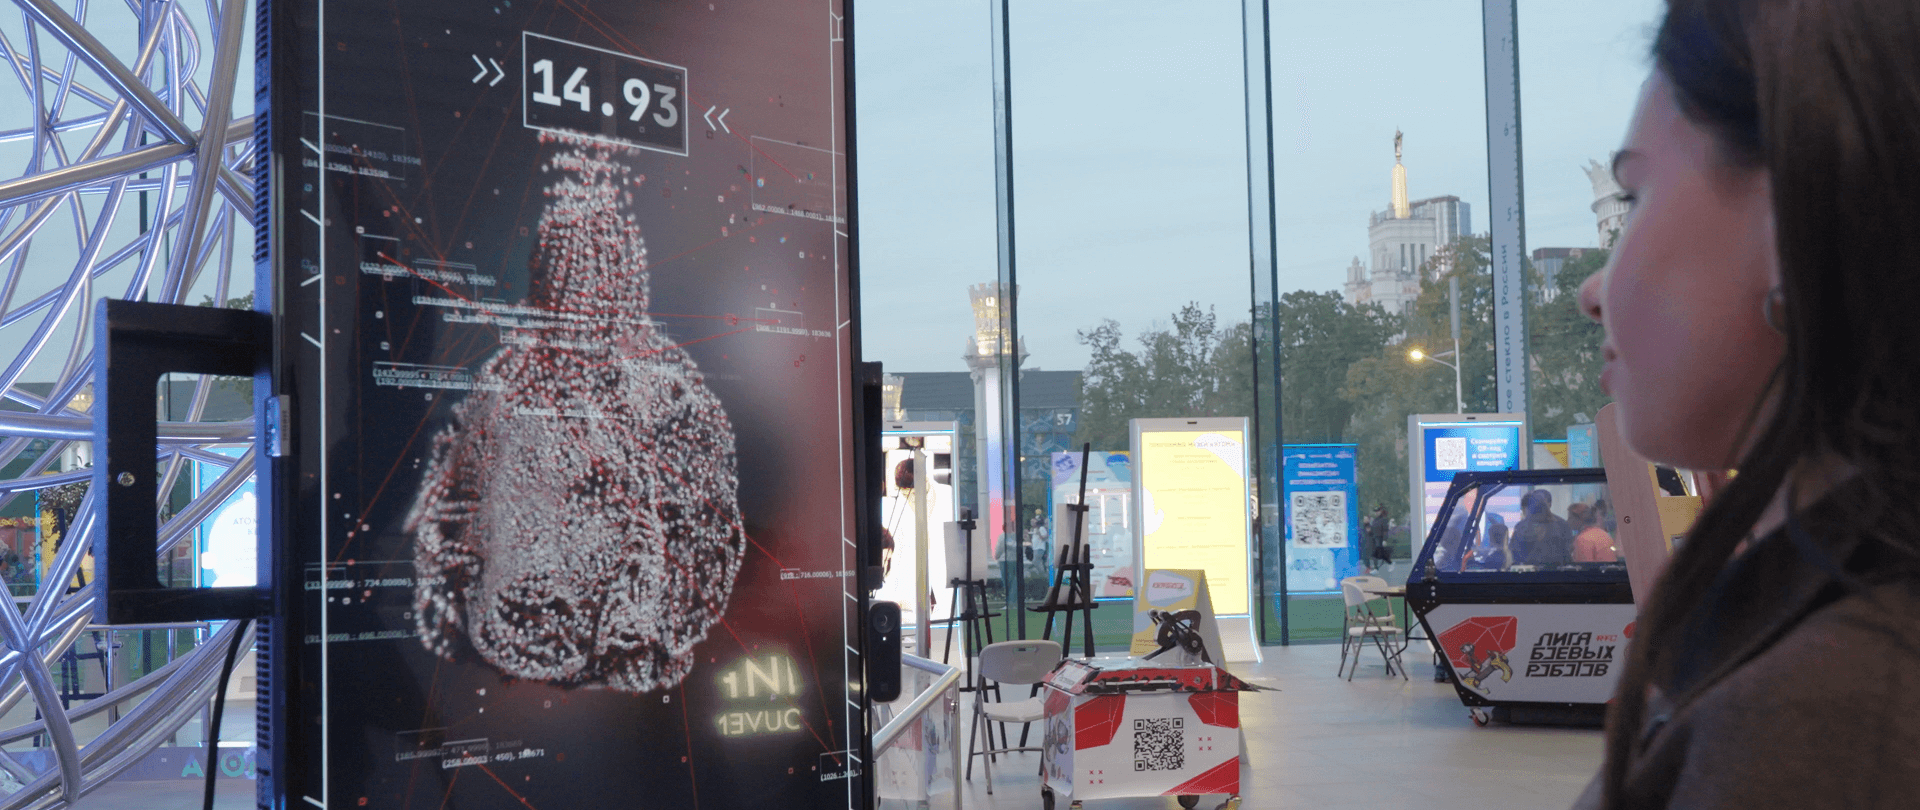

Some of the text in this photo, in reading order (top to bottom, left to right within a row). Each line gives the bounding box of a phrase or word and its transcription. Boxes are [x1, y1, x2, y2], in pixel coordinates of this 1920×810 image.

[532, 59, 679, 128] 14.93
[1501, 244, 1510, 306] России
[1504, 311, 1510, 320] в
[1057, 414, 1072, 426] 57
[1534, 632, 1592, 646] ЛИГА
[1530, 646, 1616, 660] БОЕВЫХ
[1525, 662, 1609, 677] РОБОТОВ
